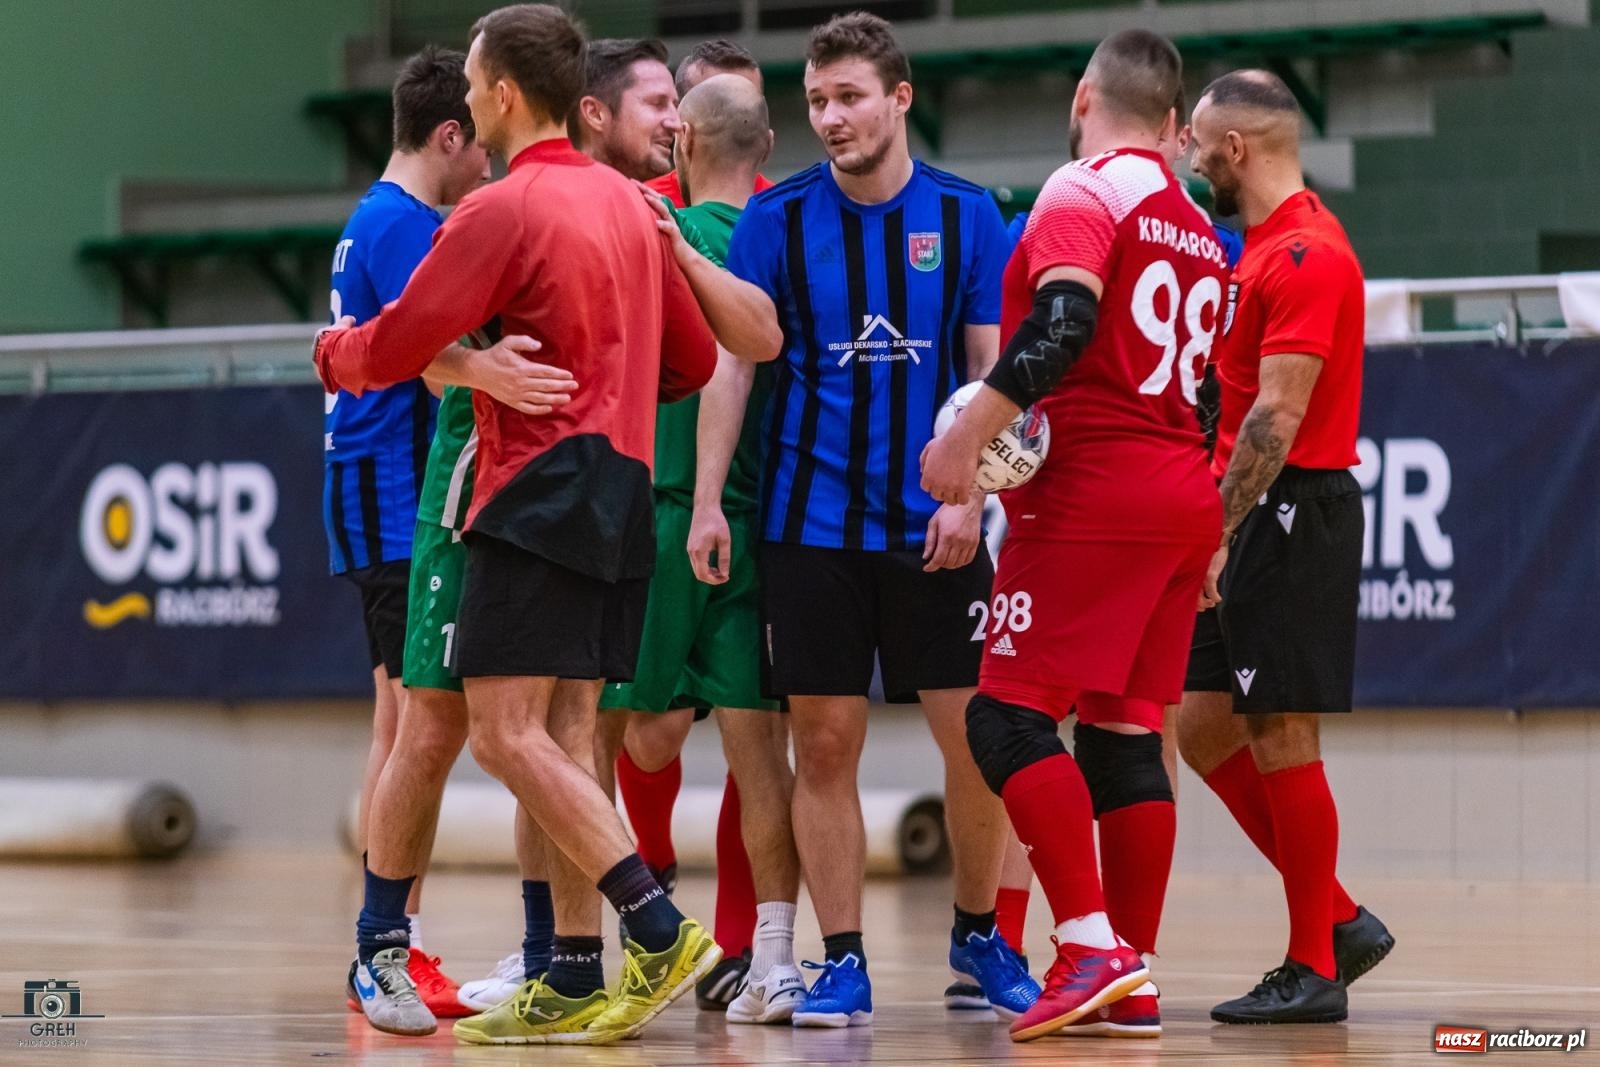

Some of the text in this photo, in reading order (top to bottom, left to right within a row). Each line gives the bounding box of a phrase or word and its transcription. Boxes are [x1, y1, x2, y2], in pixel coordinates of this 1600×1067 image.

[828, 343, 853, 351] USŁUGI
[854, 340, 888, 349] DEKARSKO
[893, 339, 933, 348] BLACHARSKIE
[1131, 260, 1222, 406] 98
[987, 437, 1034, 477] SELECT
[991, 590, 1033, 634] 98
